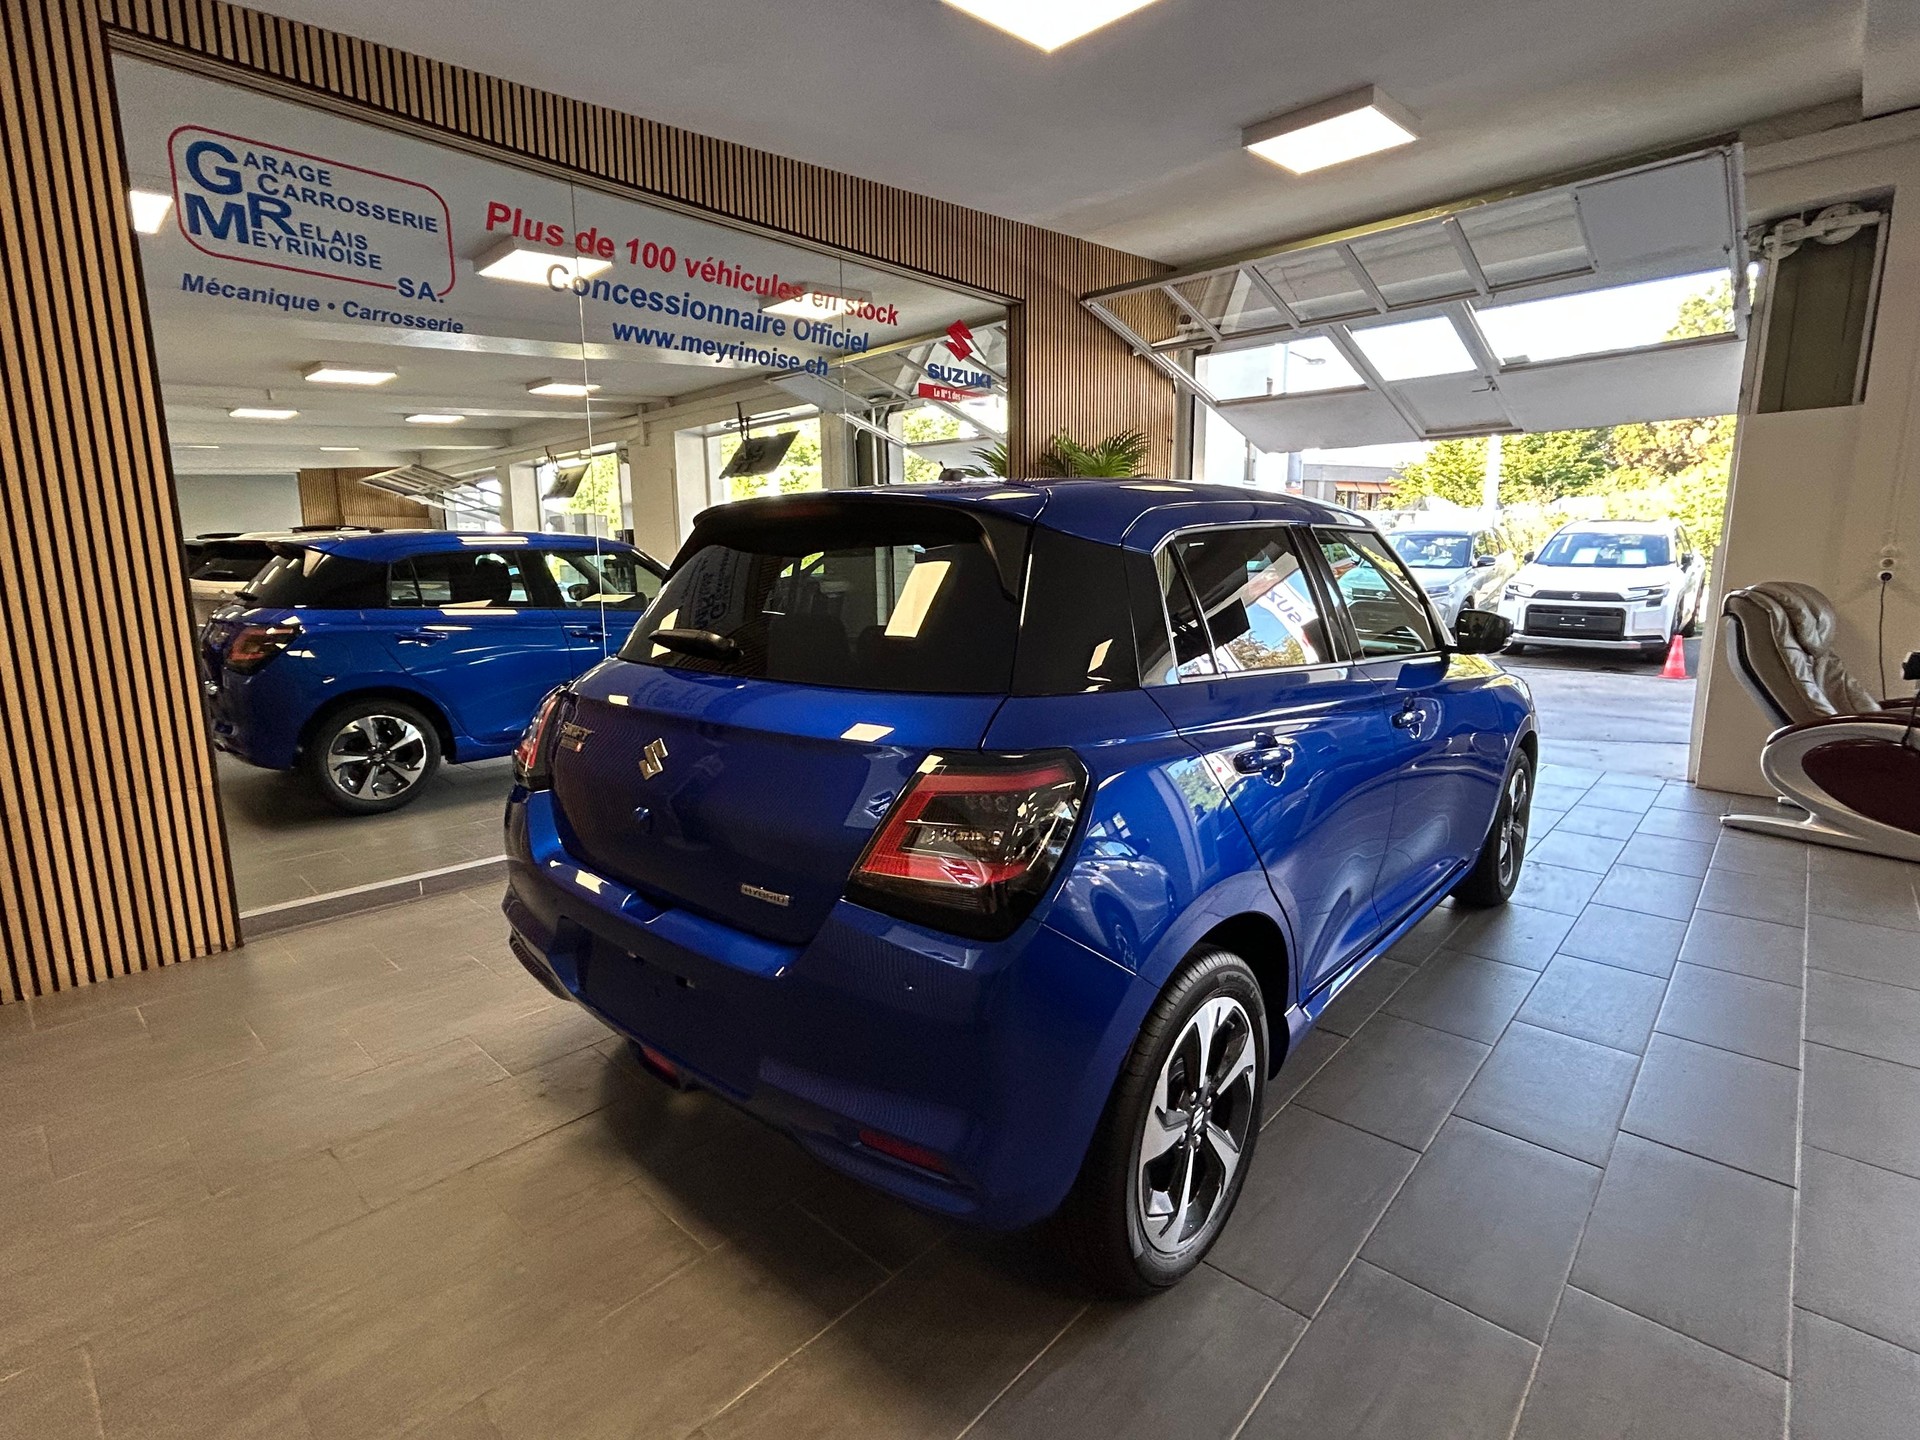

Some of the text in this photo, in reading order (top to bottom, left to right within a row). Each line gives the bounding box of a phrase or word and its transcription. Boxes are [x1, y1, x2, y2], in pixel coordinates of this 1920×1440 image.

[185, 140, 332, 195] GARAGE
[184, 192, 382, 271] MEYRINOISE
[246, 192, 368, 250] RELAIS
[257, 172, 438, 233] CARROSSERIE
[486, 200, 899, 327] Plus de 100 véhicules en stock
[181, 272, 464, 334] Mécanique Carrosserie
[546, 263, 869, 353] Concessionnaire Officiel
[612, 320, 829, 376] www.meyrinoise.ch
[927, 362, 992, 389] SUZUKI
